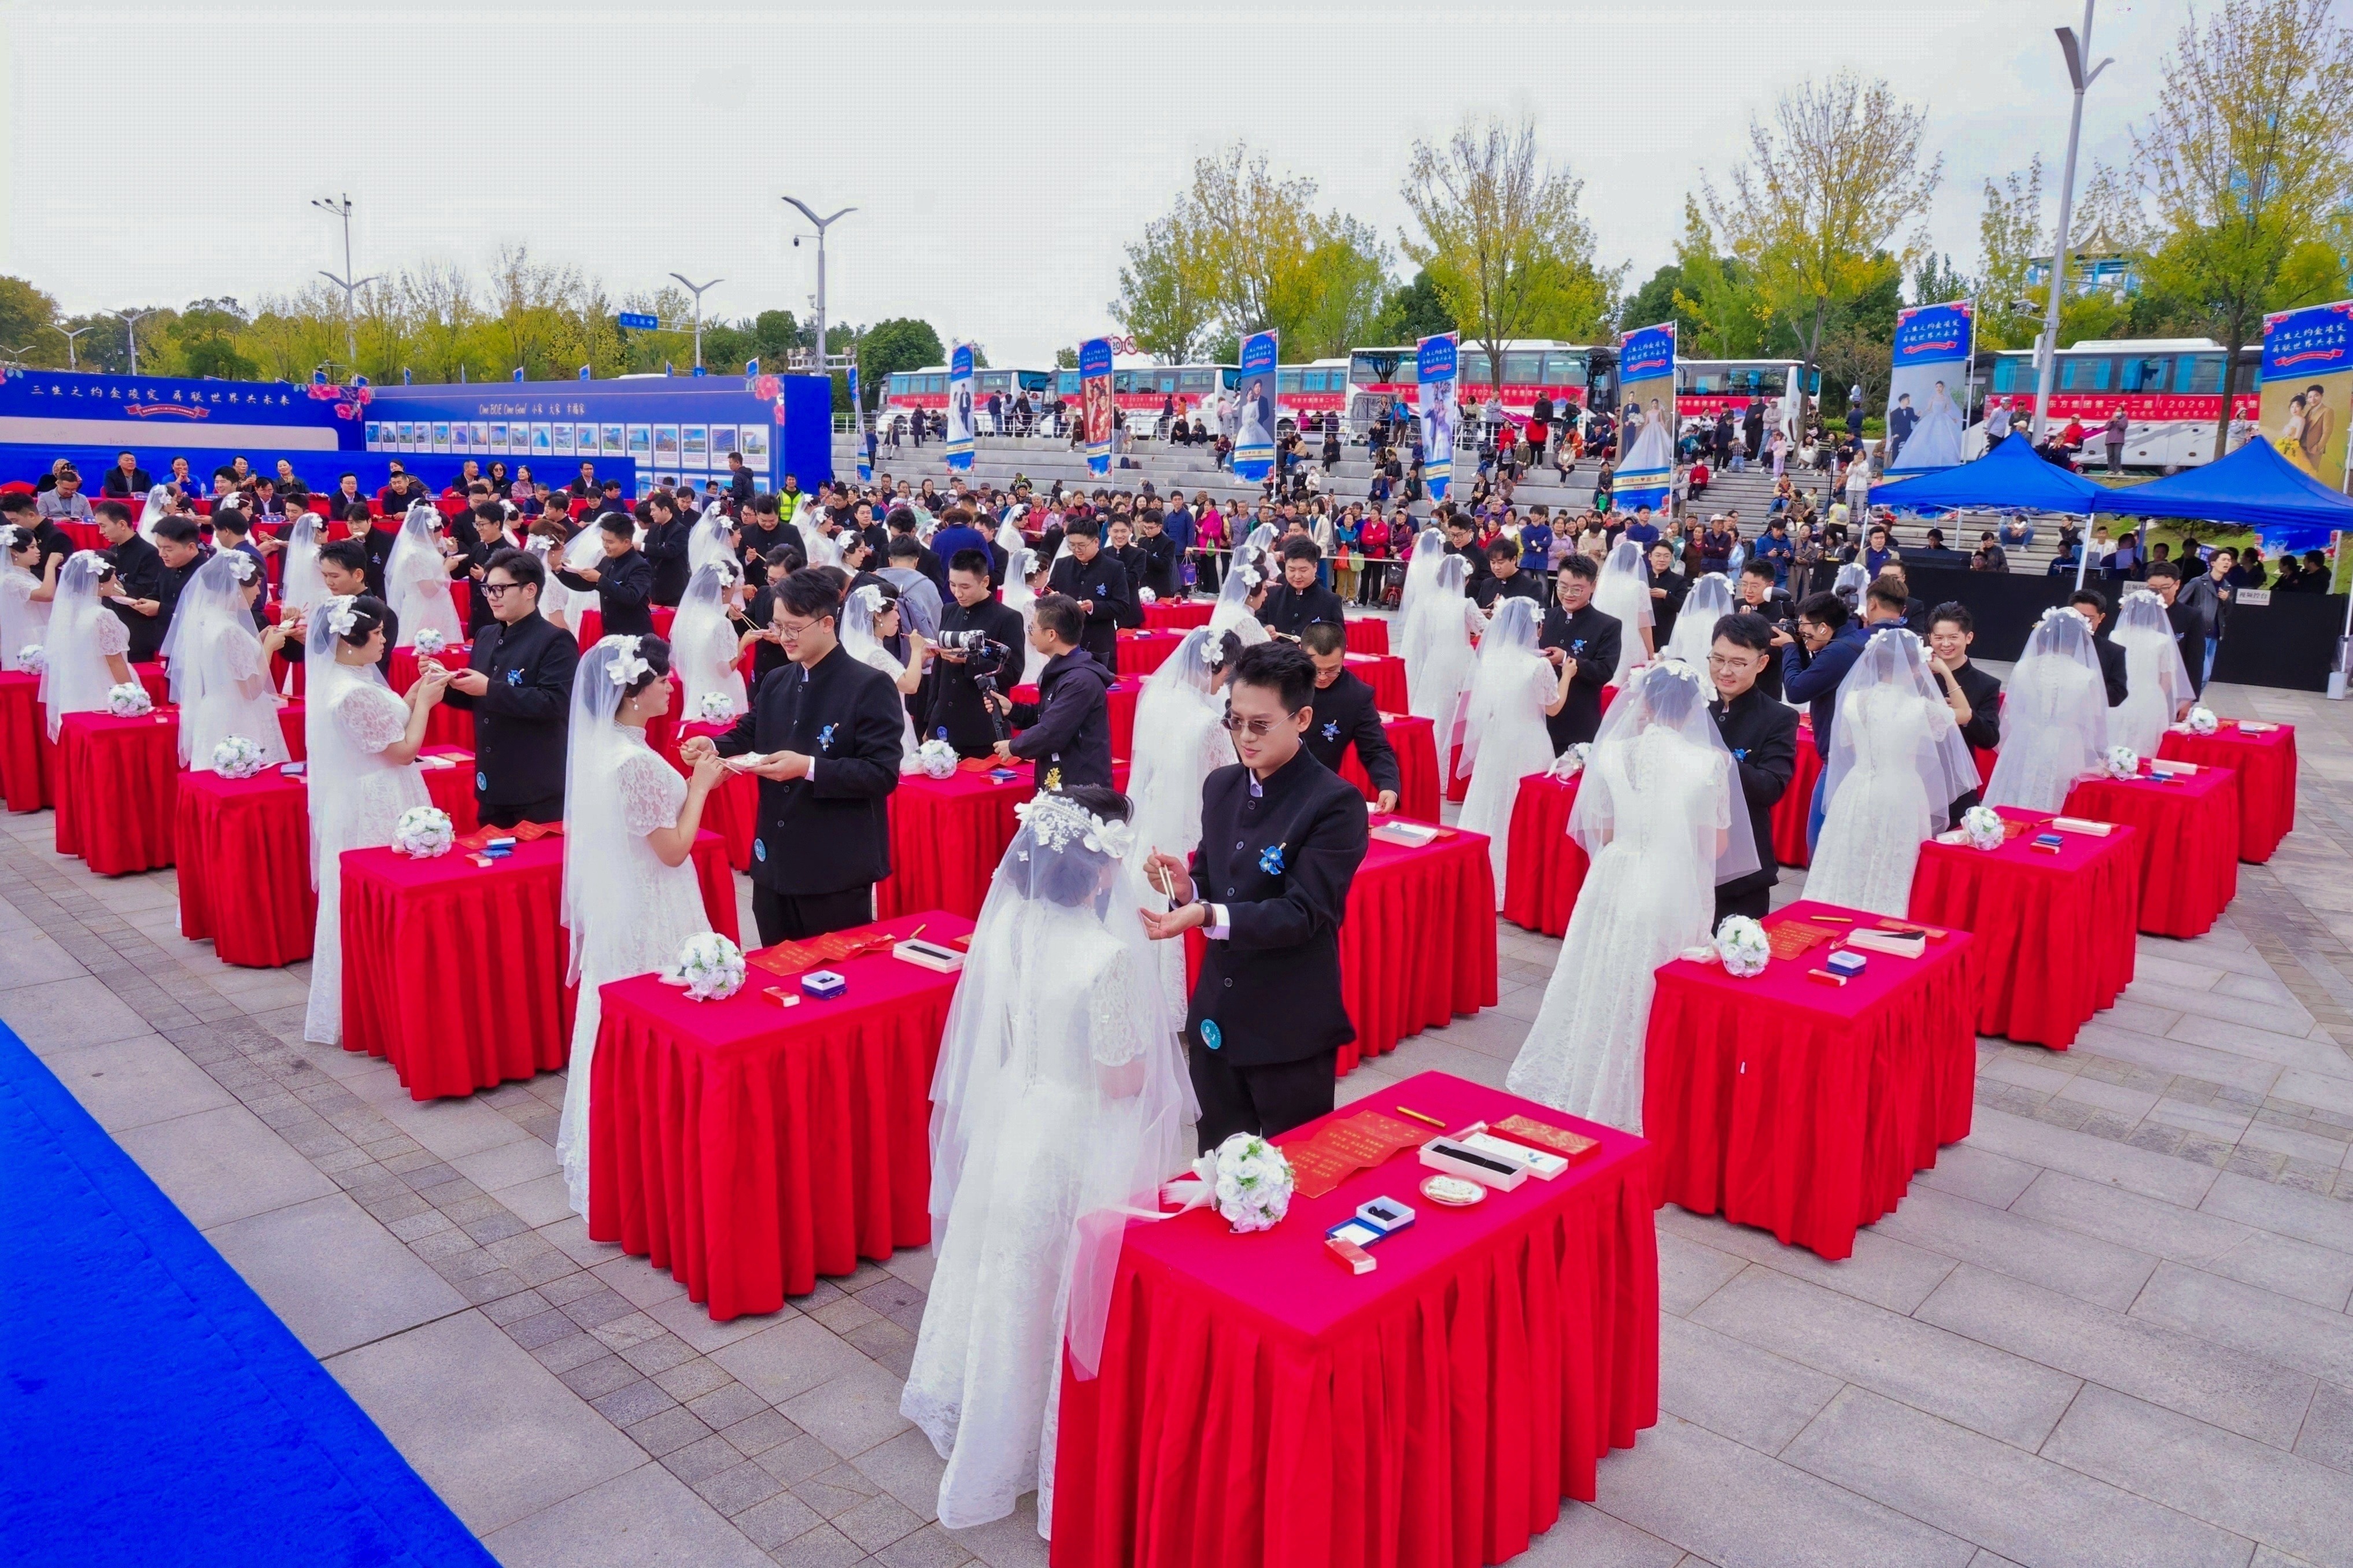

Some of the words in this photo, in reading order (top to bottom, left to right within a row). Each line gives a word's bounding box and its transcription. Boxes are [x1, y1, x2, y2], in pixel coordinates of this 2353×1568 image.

[2273, 323, 2347, 342] 三生之约金陵定
[31, 385, 160, 401] 三生之约金陵定
[172, 390, 290, 406] 屏联世界共未来
[479, 404, 489, 415] One
[490, 404, 502, 415] BOE
[504, 404, 514, 415] One
[515, 403, 527, 415] Goal
[532, 403, 542, 415] 小家
[549, 403, 560, 415] 大家
[1205, 1026, 1216, 1041] 9-1
